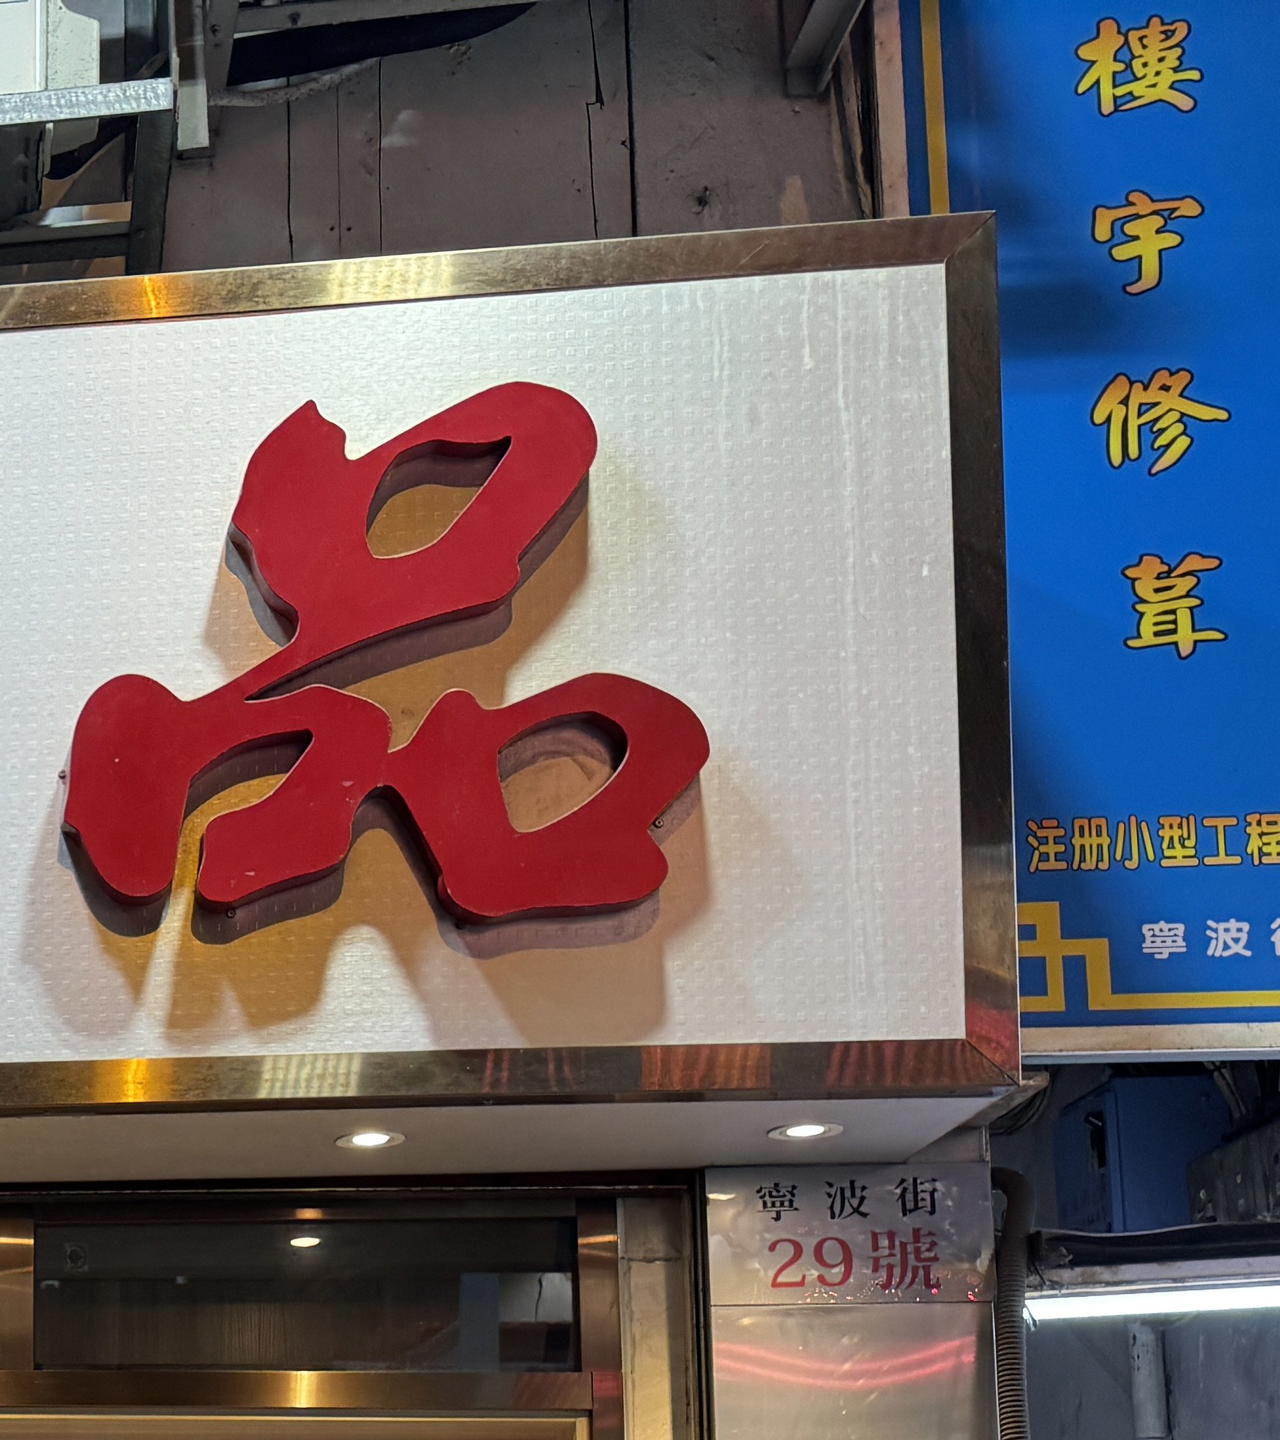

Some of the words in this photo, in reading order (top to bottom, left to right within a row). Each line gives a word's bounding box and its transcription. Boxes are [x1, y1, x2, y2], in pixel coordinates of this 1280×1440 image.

[1142, 919, 1280, 959] 寧波
[756, 1176, 939, 1222] 寧波街
[767, 1227, 940, 1291] 29號
